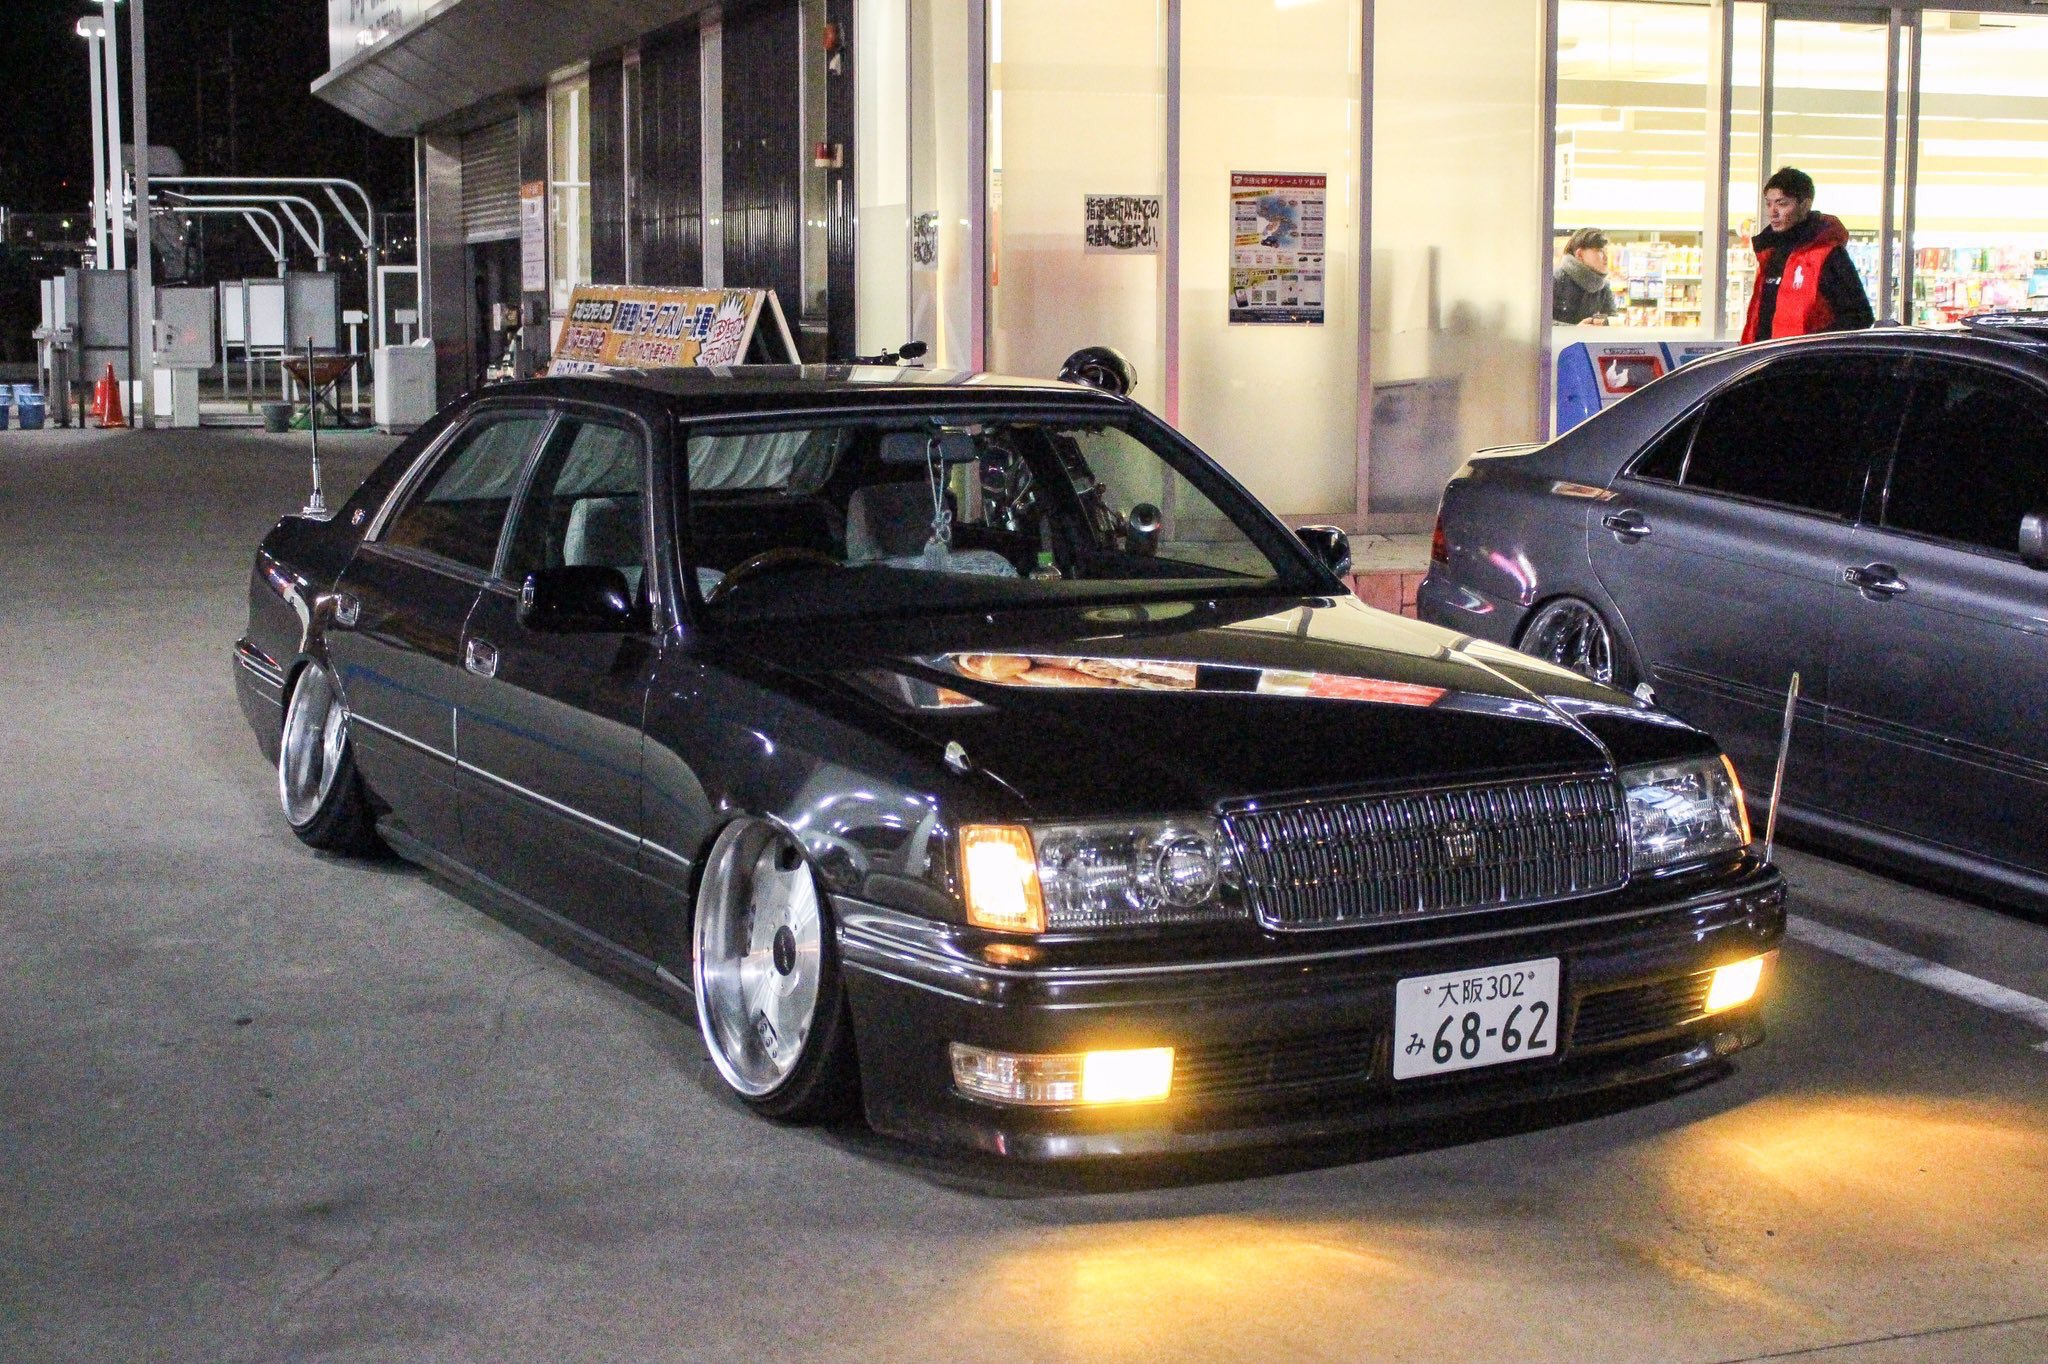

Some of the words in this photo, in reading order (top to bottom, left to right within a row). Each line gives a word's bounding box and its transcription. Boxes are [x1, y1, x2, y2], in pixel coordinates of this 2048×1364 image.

[1086, 197, 1160, 220] 指定場所以外での
[1432, 1000, 1549, 1064] 68-62
